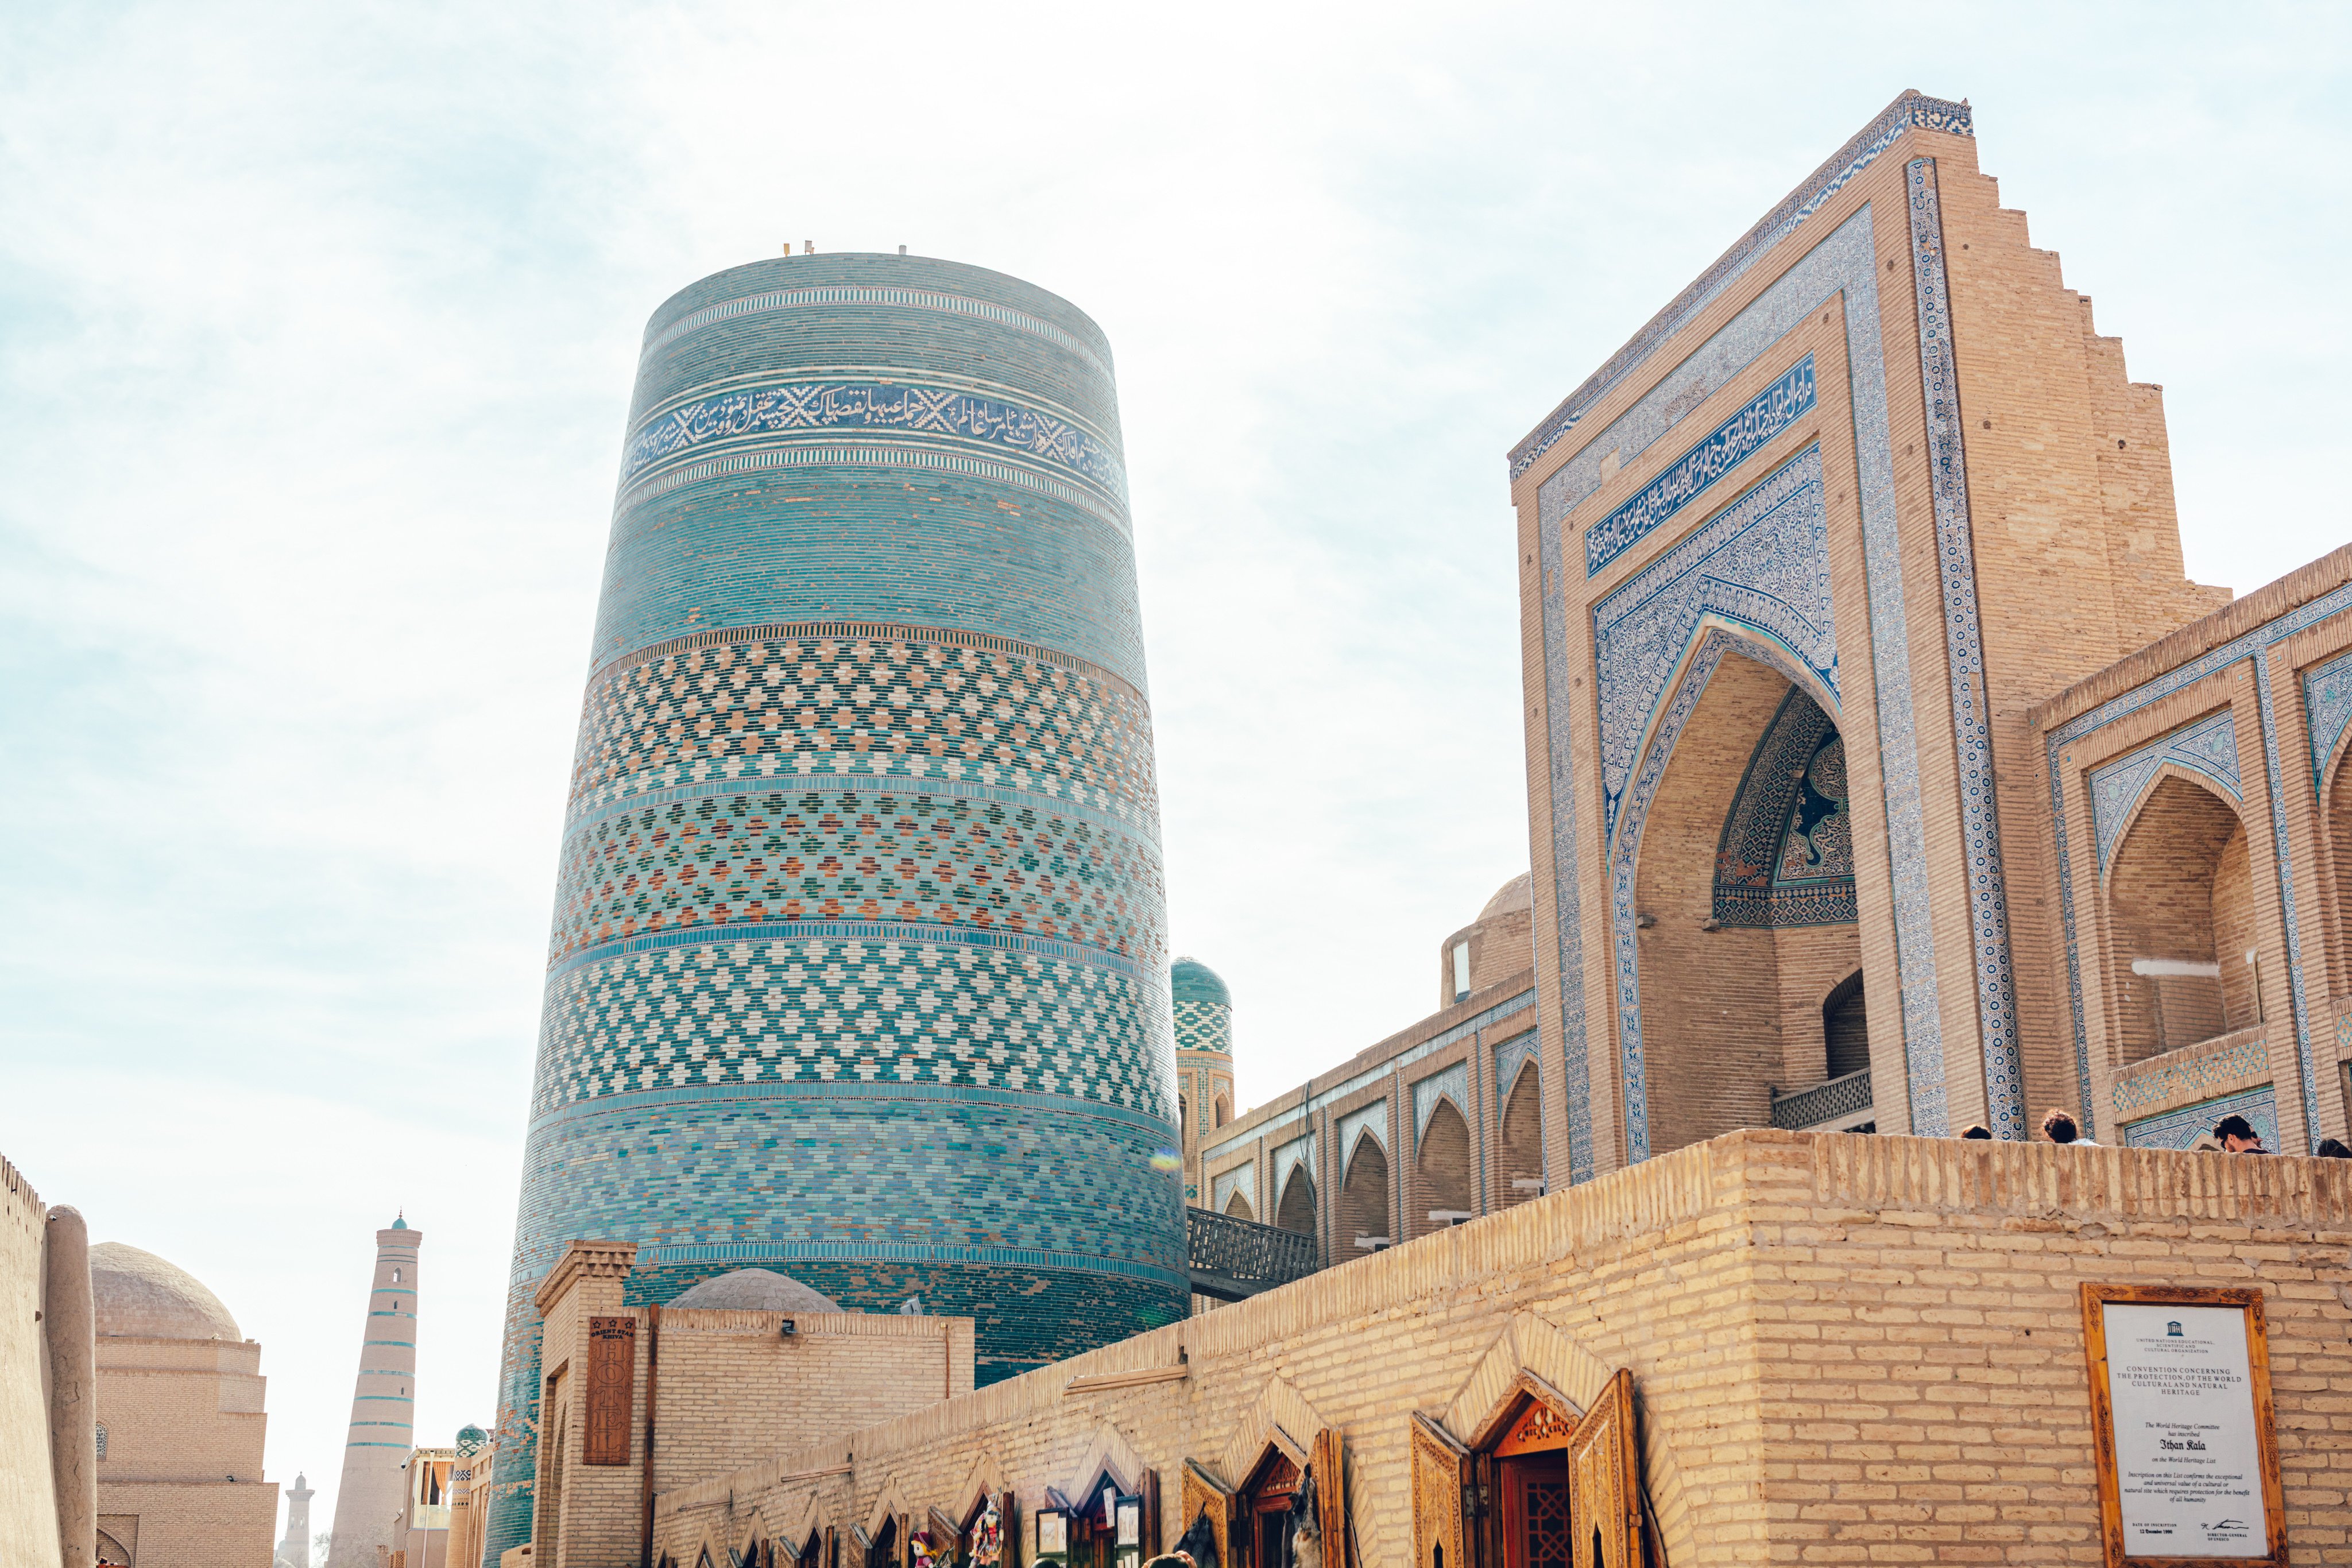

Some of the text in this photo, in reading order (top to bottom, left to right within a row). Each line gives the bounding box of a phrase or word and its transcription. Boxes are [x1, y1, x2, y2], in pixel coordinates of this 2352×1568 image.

[591, 1329, 634, 1337] ORIENT STAR
[593, 1341, 626, 1453] HOTEL
[2186, 1439, 2206, 1450] Kala
[2128, 1471, 2154, 1479] Inscription
